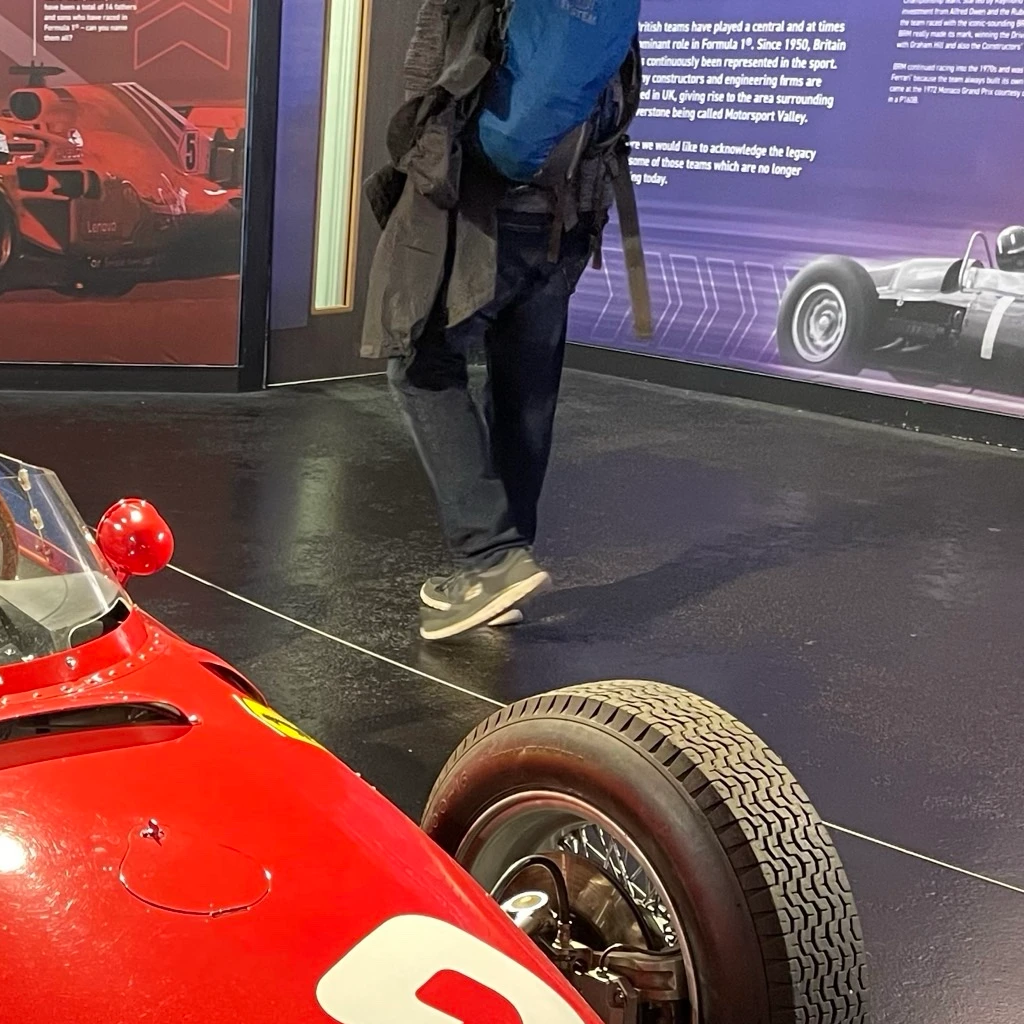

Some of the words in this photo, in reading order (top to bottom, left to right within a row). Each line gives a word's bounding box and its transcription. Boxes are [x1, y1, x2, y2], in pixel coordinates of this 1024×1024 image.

[639, 21, 662, 32] ritish
[664, 23, 689, 32] teams
[691, 21, 712, 32] have
[714, 21, 743, 34] played
[745, 23, 750, 32] a
[752, 20, 784, 32] central
[787, 20, 804, 32] and
[806, 22, 816, 32] at
[819, 20, 845, 32] times
[673, 39, 689, 49] role
[691, 38, 699, 49] in
[702, 38, 738, 49] Formula
[757, 38, 782, 50] Since
[813, 39, 846, 50] Britain
[647, 56, 699, 69] continuously
[701, 56, 722, 67] been
[724, 57, 777, 70] represented
[780, 57, 789, 68] in
[792, 57, 806, 68] the
[809, 59, 837, 71] sport.
[652, 74, 704, 84] constructors
[707, 73, 723, 84] and
[725, 74, 777, 88] engineering
[780, 75, 803, 86] firms
[806, 78, 822, 87] are
[652, 89, 659, 100] in
[679, 90, 705, 104] giving
[707, 91, 724, 102] rise
[726, 92, 735, 102] to
[738, 92, 752, 103] the
[754, 95, 774, 103] area
[776, 94, 834, 108] surrounding
[672, 107, 695, 121] being
[697, 108, 723, 119] called
[725, 109, 775, 123] Motorsport
[778, 110, 808, 125] Valley.
[642, 142, 654, 150] we
[656, 141, 680, 151] would
[682, 141, 697, 152] like
[700, 143, 708, 153] to
[710, 144, 767, 158] acknowledge
[769, 146, 783, 157] the
[786, 147, 816, 161] legacy
[628, 157, 649, 166] some
[651, 157, 660, 167] of
[662, 157, 684, 168] those
[686, 160, 711, 170] teams
[714, 160, 739, 171] which
[741, 164, 756, 173] are
[758, 165, 769, 173] no
[772, 163, 802, 178] longer
[87, 220, 117, 233] Lenovo
